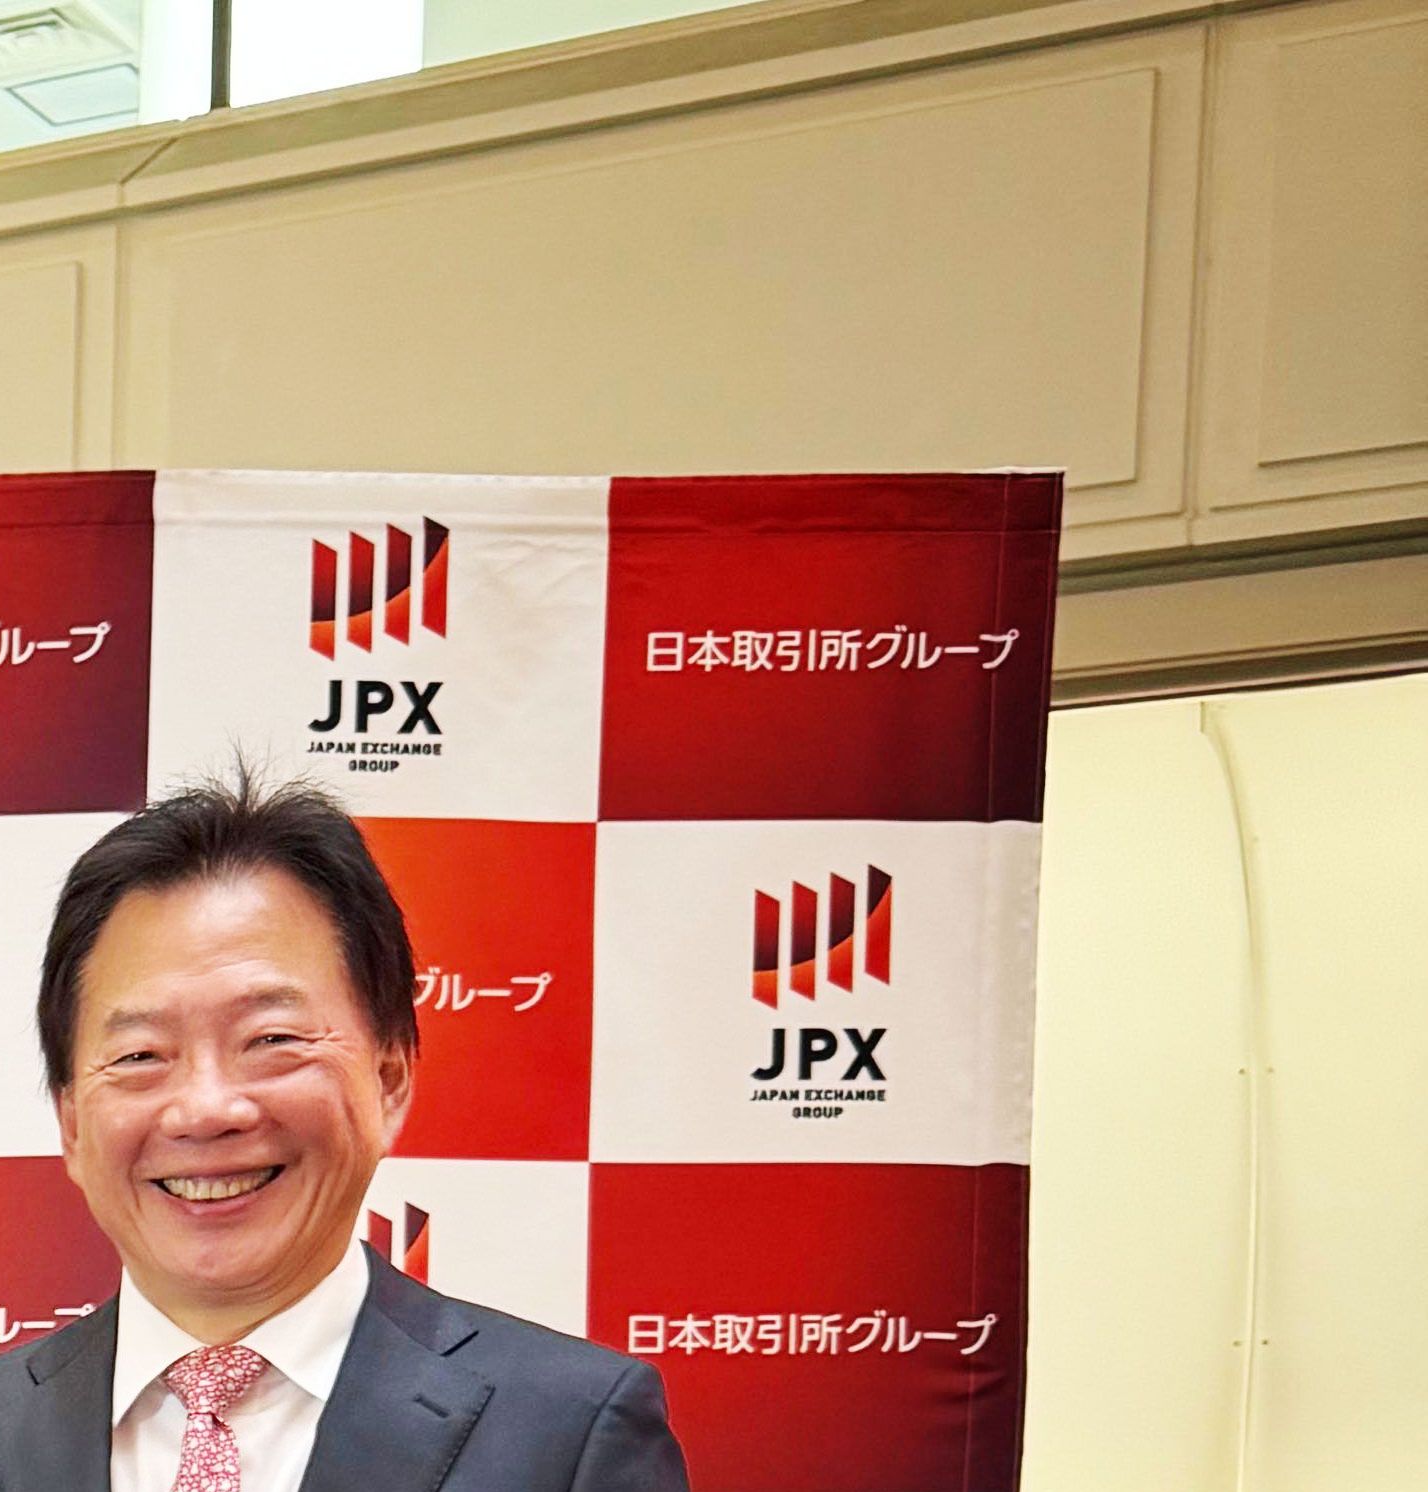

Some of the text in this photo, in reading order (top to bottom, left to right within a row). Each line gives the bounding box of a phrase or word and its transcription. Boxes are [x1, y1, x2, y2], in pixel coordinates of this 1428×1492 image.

[647, 629, 1019, 672] 日本取引所グループ
[308, 679, 444, 735] JPX
[306, 741, 443, 757] JAPAN EXCHANGE
[348, 759, 400, 773] GROUP
[751, 1027, 887, 1081] JPX
[749, 1088, 887, 1102] JAPAN EXCHANGE
[791, 1105, 844, 1119] GROUP
[628, 1310, 997, 1355] 日本取引所グループ
